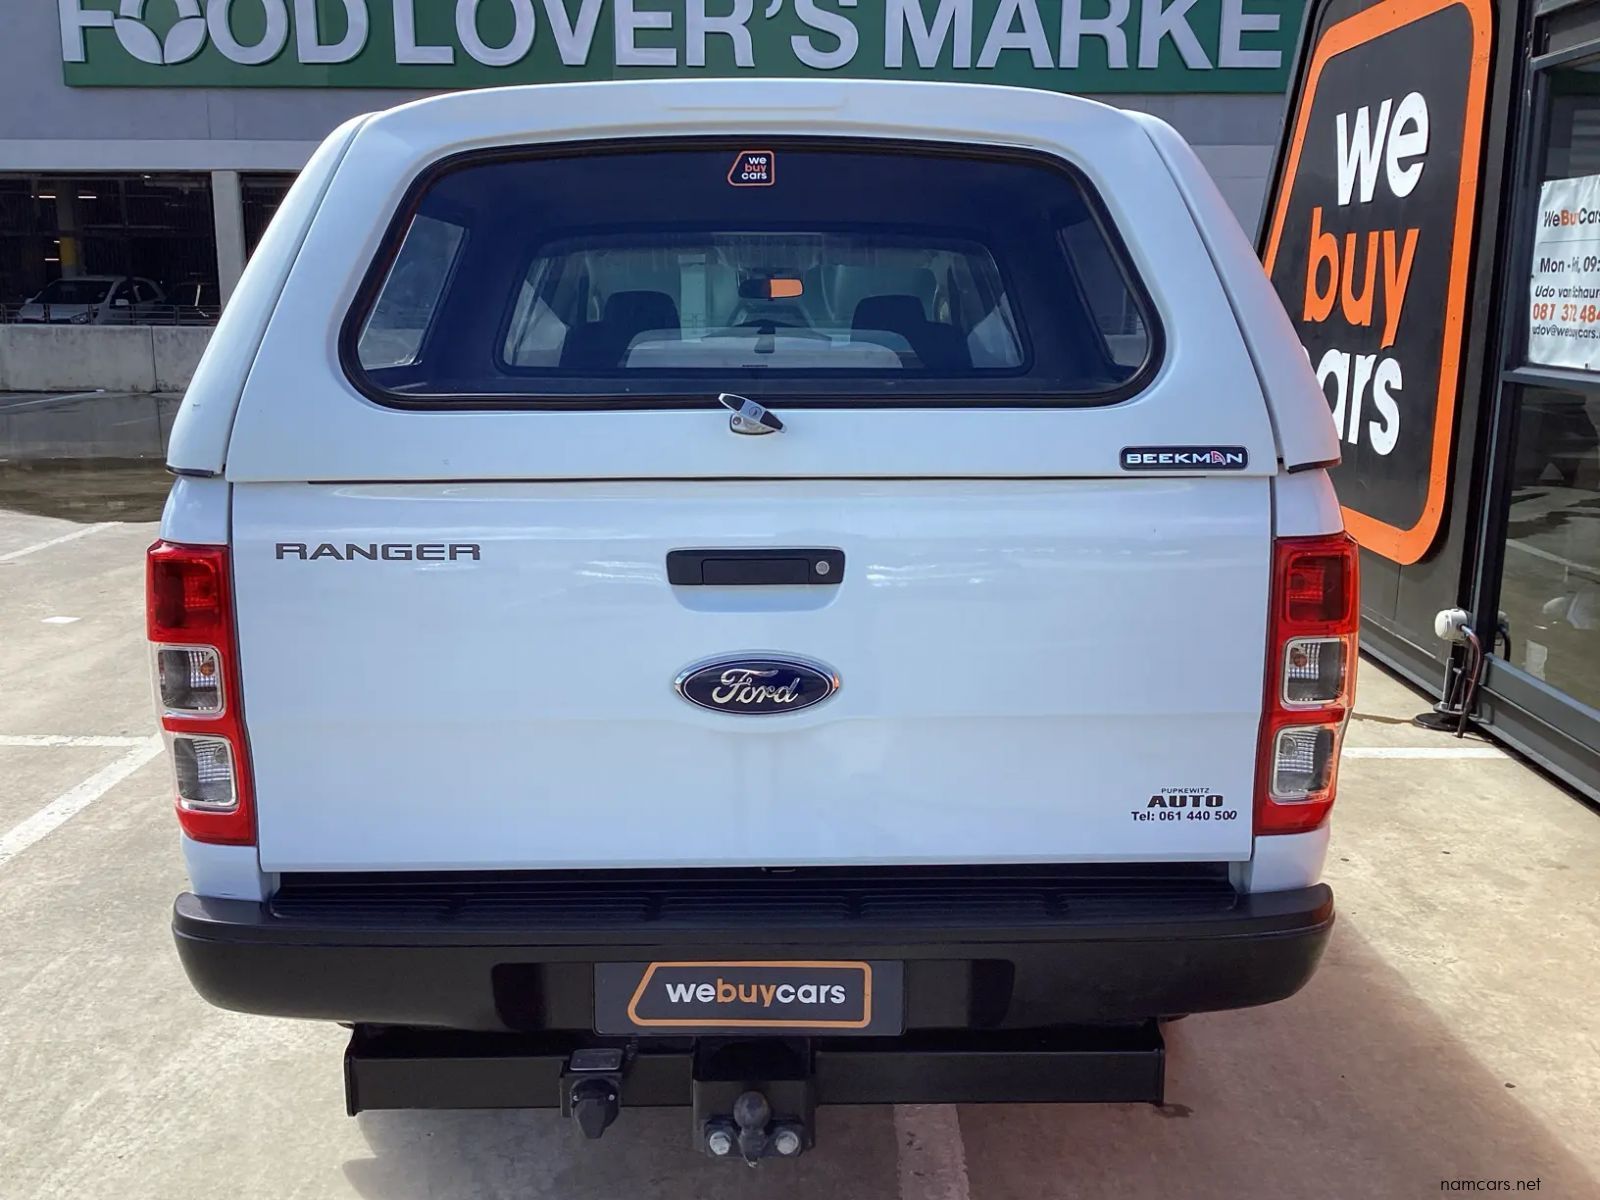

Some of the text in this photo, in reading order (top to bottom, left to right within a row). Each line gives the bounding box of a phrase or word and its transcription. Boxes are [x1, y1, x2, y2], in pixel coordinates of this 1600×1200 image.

[395, 0, 859, 69] LOVER'S
[1335, 91, 1430, 206] we
[741, 172, 767, 180] cars
[745, 163, 767, 172] buy
[1540, 257, 1565, 272] Mon
[1303, 207, 1420, 349] buy
[1535, 285, 1555, 297] Udo
[1302, 345, 1403, 457] ars
[1126, 450, 1243, 466] BEEKMAN
[275, 542, 481, 561] RANGER
[711, 668, 800, 704] Ford
[1147, 794, 1224, 808] AUTO
[1131, 811, 1155, 821] Tel:
[1159, 811, 1182, 821] 061
[1186, 810, 1211, 821] 440
[665, 978, 847, 1008] webuycars
